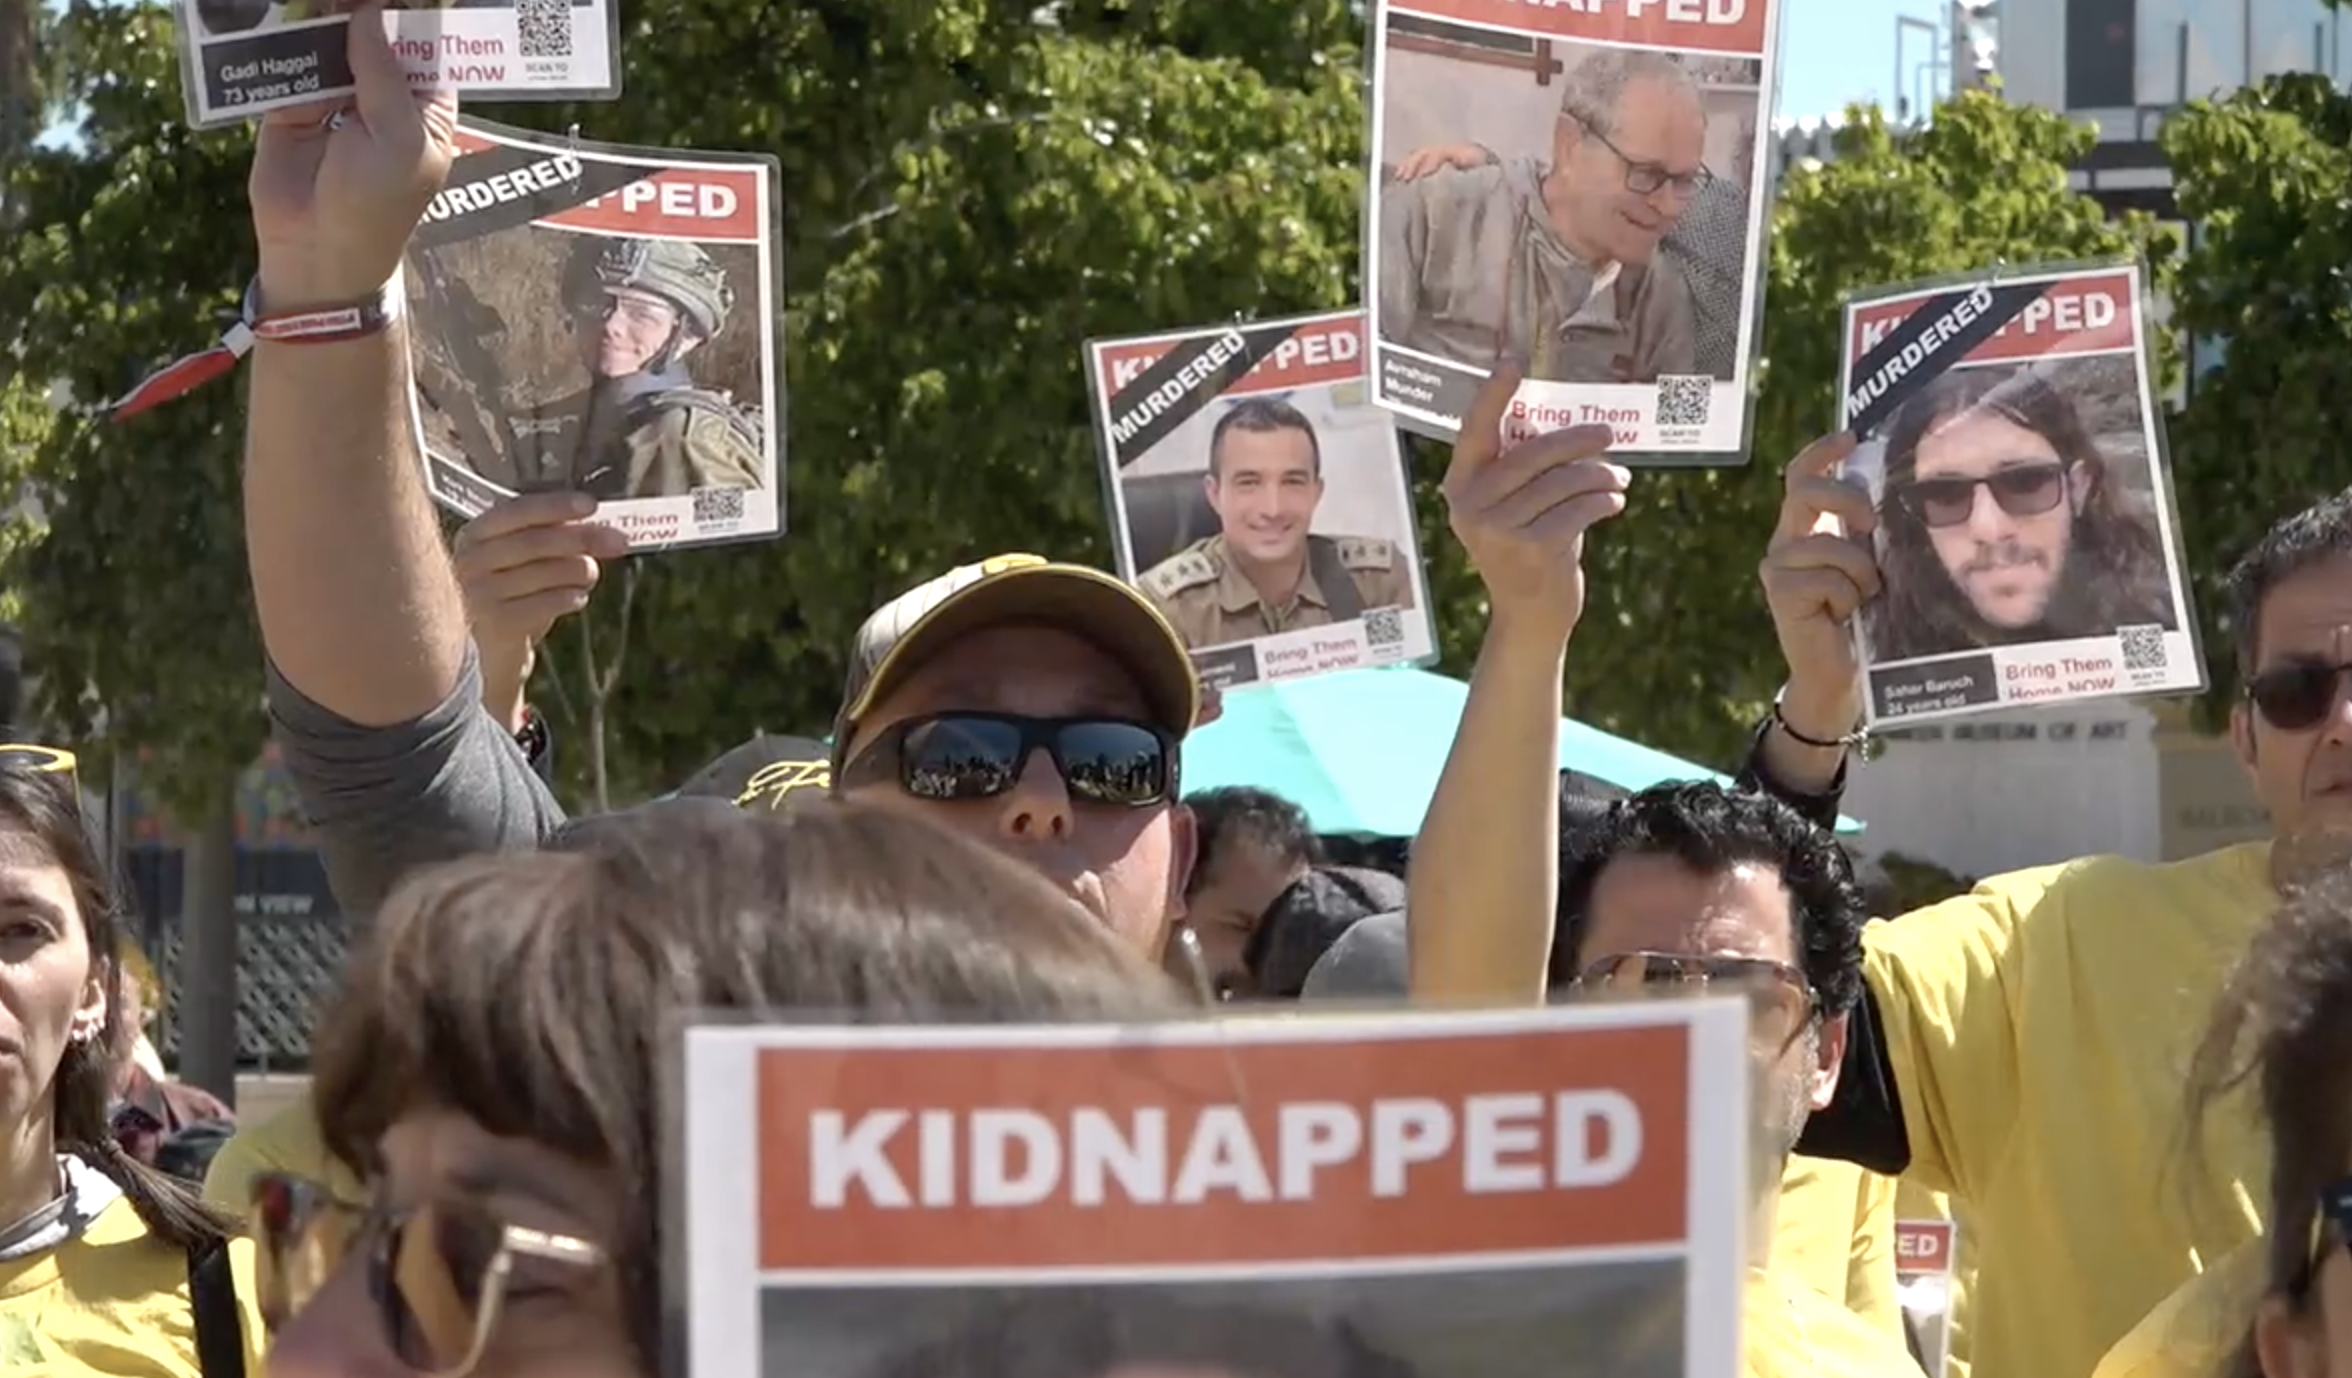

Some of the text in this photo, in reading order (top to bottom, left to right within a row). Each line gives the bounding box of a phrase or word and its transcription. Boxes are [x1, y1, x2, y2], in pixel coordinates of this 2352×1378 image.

[440, 35, 504, 55] Them
[221, 60, 258, 82] Gadi
[223, 75, 319, 104] 73 years old
[1849, 285, 1994, 419] MURDERED
[1110, 328, 1245, 444] MURDERED
[1512, 400, 1640, 426] Bring Them
[2005, 657, 2113, 681] Bring Them
[1944, 692, 1967, 706] old
[2090, 720, 2128, 740] ART
[807, 1086, 1644, 1208] KIDNAPPED
